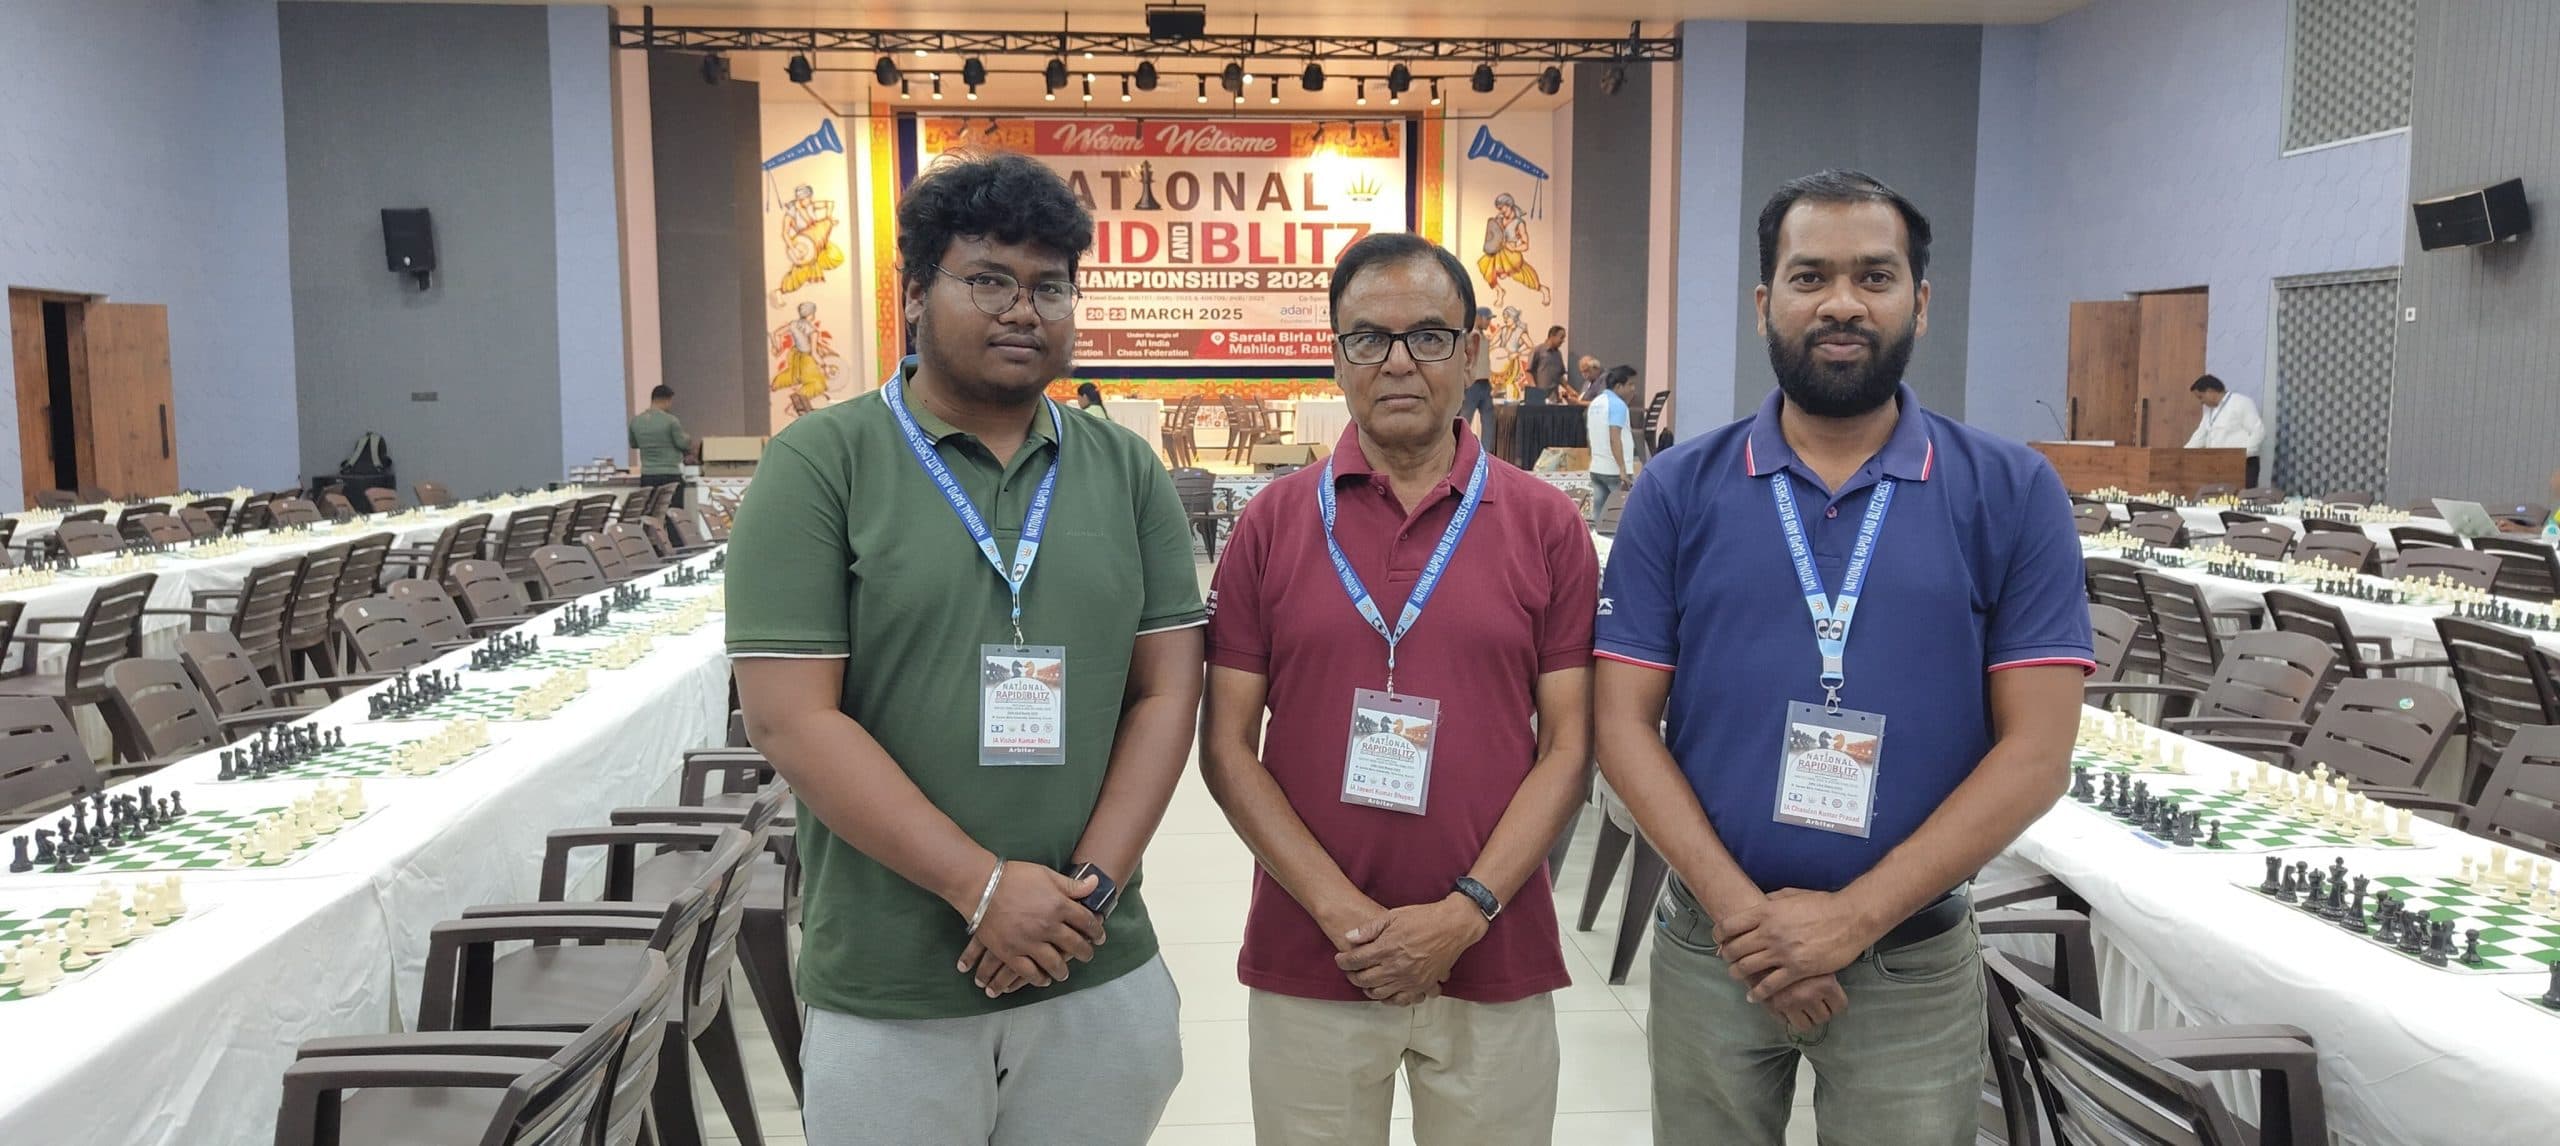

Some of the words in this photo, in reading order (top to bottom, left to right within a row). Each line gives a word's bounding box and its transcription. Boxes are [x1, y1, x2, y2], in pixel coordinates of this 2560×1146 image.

[1053, 123, 1144, 153] Warm
[1156, 122, 1278, 154] Welcome
[1172, 225, 1189, 260] AND
[1079, 271, 1260, 289] AMPIONSHIPS
[1131, 308, 1194, 320] MARCH
[1199, 308, 1243, 320] 2025
[1280, 304, 1312, 316] adani
[1148, 339, 1170, 347] India
[1279, 332, 1313, 343] Birla
[1117, 349, 1142, 357] Chess
[1144, 349, 1189, 357] Federation
[1229, 343, 1298, 355] Mahilong,
[913, 437, 932, 460] CHESS
[925, 456, 945, 476] BLITZ
[938, 473, 954, 488] AND
[947, 486, 967, 507] RAPID
[1034, 489, 1050, 508] RAPID
[1774, 480, 1790, 502] CHESS
[1874, 480, 1892, 502] CHESS
[1451, 507, 1469, 528] CHESS
[1779, 501, 1796, 521] BLITZ
[1867, 501, 1884, 520] BLITZ
[960, 504, 987, 537] NATIONAL
[1025, 508, 1045, 537] NATIONAL
[1785, 519, 1800, 535] AND
[1862, 519, 1877, 536] AND
[1442, 525, 1459, 545] BLITZ
[1437, 541, 1450, 556] AND
[1789, 535, 1807, 557] RAPID
[1854, 535, 1872, 557] RAPID
[1427, 555, 1444, 576] RAPID
[1797, 556, 1818, 591] NATIONAL
[1843, 558, 1865, 592] NATIONAL
[1412, 572, 1436, 604] NATIONAL
[996, 691, 1022, 699] RAPID
[1026, 692, 1050, 700] BLITZ
[1003, 682, 1045, 691] NATIONAL
[1362, 743, 1388, 753] RAPID
[1392, 748, 1416, 759] BLITZ
[1370, 736, 1411, 750] NATIONAL
[1799, 760, 1827, 770] RAPID
[1833, 766, 1859, 776] BLITZ
[1807, 753, 1852, 767] NATIONAL
[1368, 798, 1393, 808] Arbiter
[1805, 819, 1836, 829] Arbiter
